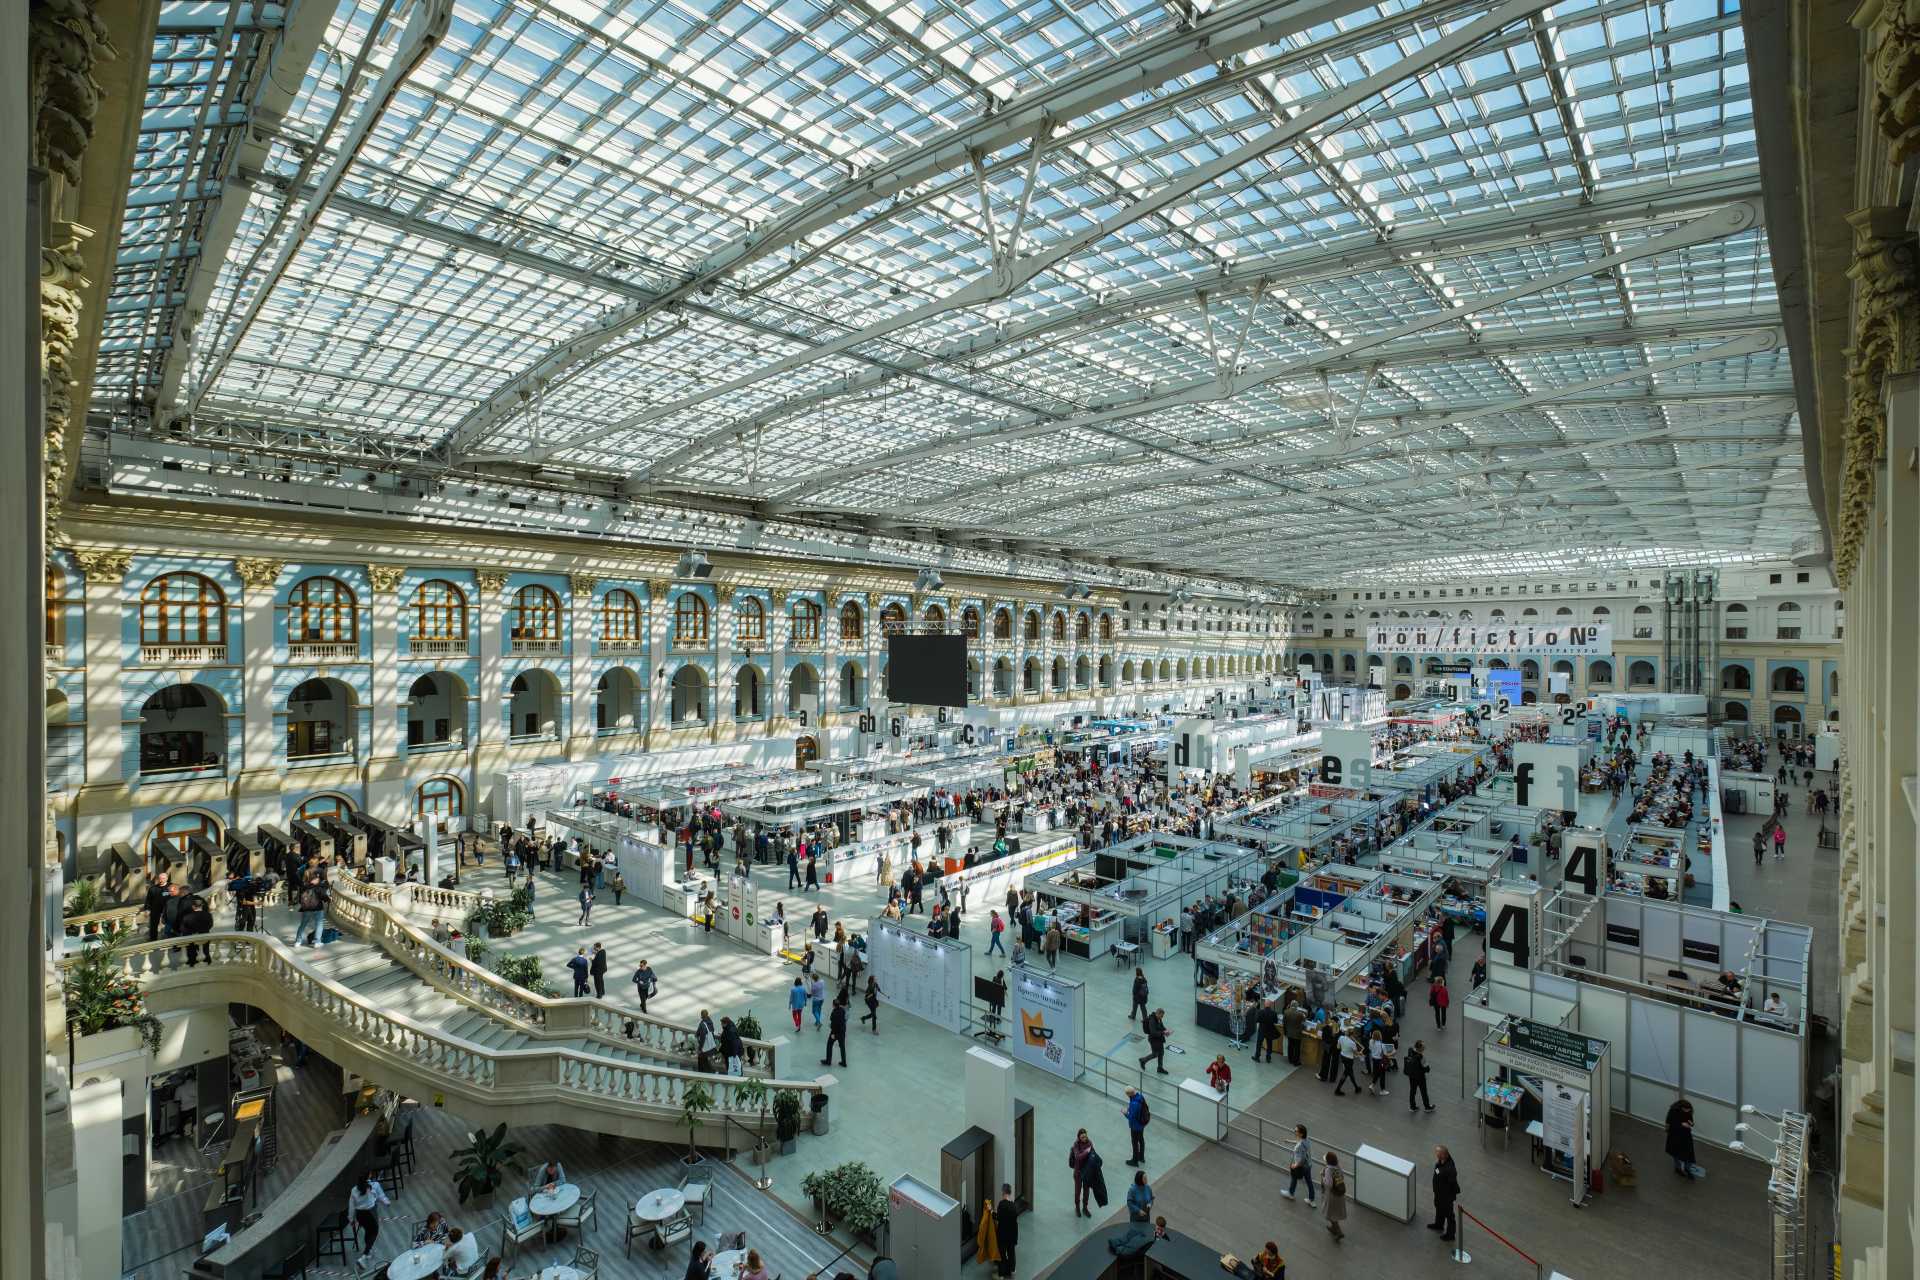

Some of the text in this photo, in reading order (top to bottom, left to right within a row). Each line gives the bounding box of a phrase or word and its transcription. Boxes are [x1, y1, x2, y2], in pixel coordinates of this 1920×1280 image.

[939, 706, 946, 723] 6
[1480, 704, 1491, 720] 2
[1499, 699, 1509, 713] 2
[1576, 702, 1586, 718] 2
[1563, 708, 1574, 725] 2
[892, 717, 900, 737] 6
[1174, 733, 1189, 766] d
[1322, 756, 1342, 784] e
[1513, 763, 1534, 806] f
[1565, 846, 1597, 896] 4
[1490, 904, 1529, 969] 4
